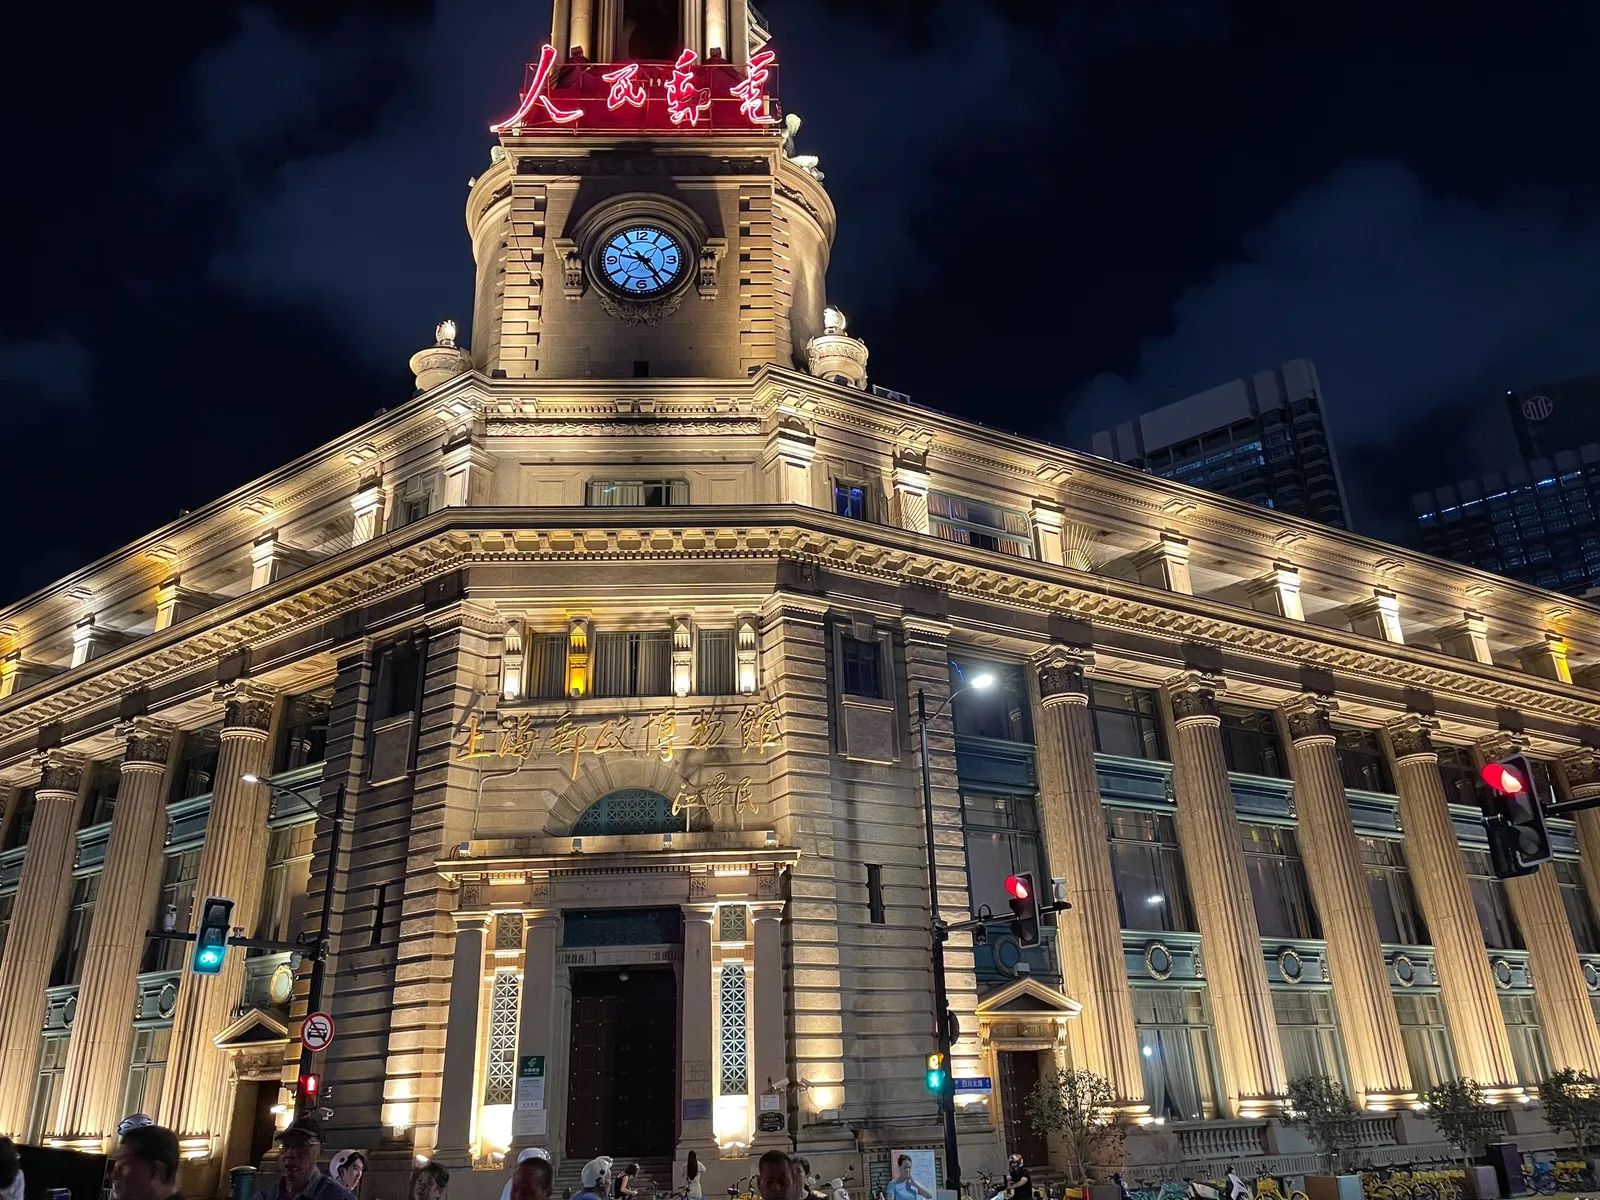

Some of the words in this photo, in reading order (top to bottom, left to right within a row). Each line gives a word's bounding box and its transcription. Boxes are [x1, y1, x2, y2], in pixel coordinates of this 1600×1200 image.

[636, 232, 648, 240] 12
[607, 256, 618, 265] 9
[665, 255, 677, 264] 3
[636, 280, 647, 289] 6
